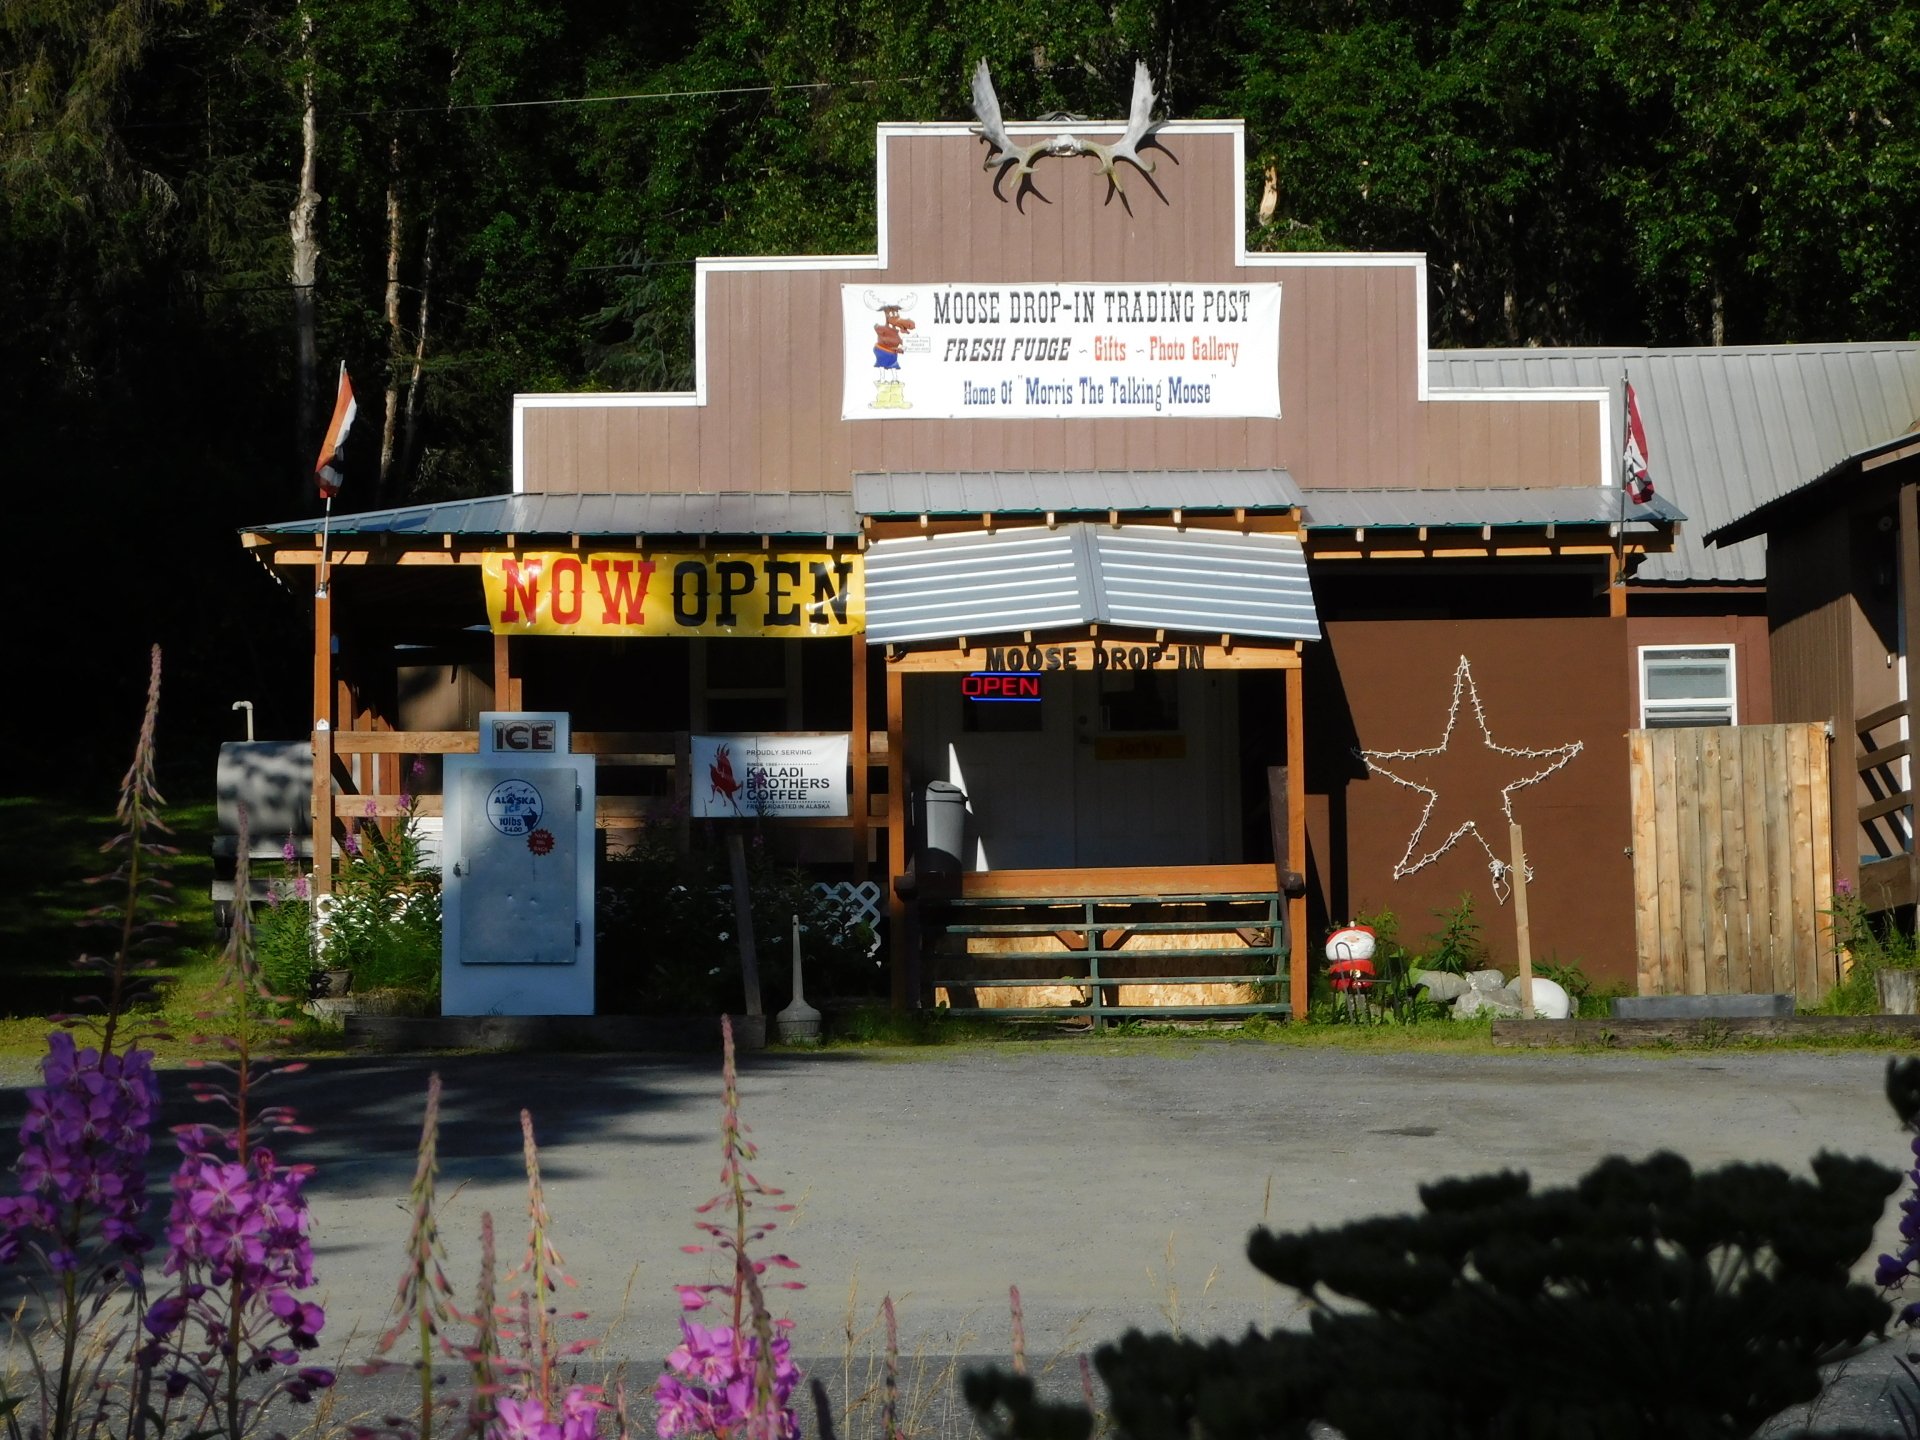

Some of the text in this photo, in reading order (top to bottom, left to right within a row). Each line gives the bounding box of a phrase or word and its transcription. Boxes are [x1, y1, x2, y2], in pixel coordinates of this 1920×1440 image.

[933, 290, 1251, 325] MOOSE DROP-IN TRADING POST
[943, 338, 1007, 362] FRESH
[1010, 337, 1072, 362] FUDGE
[1094, 335, 1127, 362] Gifts
[1149, 335, 1186, 361] Photo
[1192, 335, 1239, 367] Gallery
[963, 380, 996, 406] Home
[1000, 379, 1013, 405] Of
[1079, 377, 1104, 404] The
[1110, 377, 1162, 411] Talking
[500, 558, 854, 627] NOW OPEN
[984, 645, 1205, 672] MOOSE DROP-IN
[962, 676, 1039, 696] OPEN
[494, 721, 554, 750] ICE
[746, 767, 804, 777] KALADI
[746, 778, 830, 789] BROTHERS
[494, 793, 536, 805] ALASKA
[746, 789, 807, 800] COFFEE
[504, 803, 521, 814] ICE
